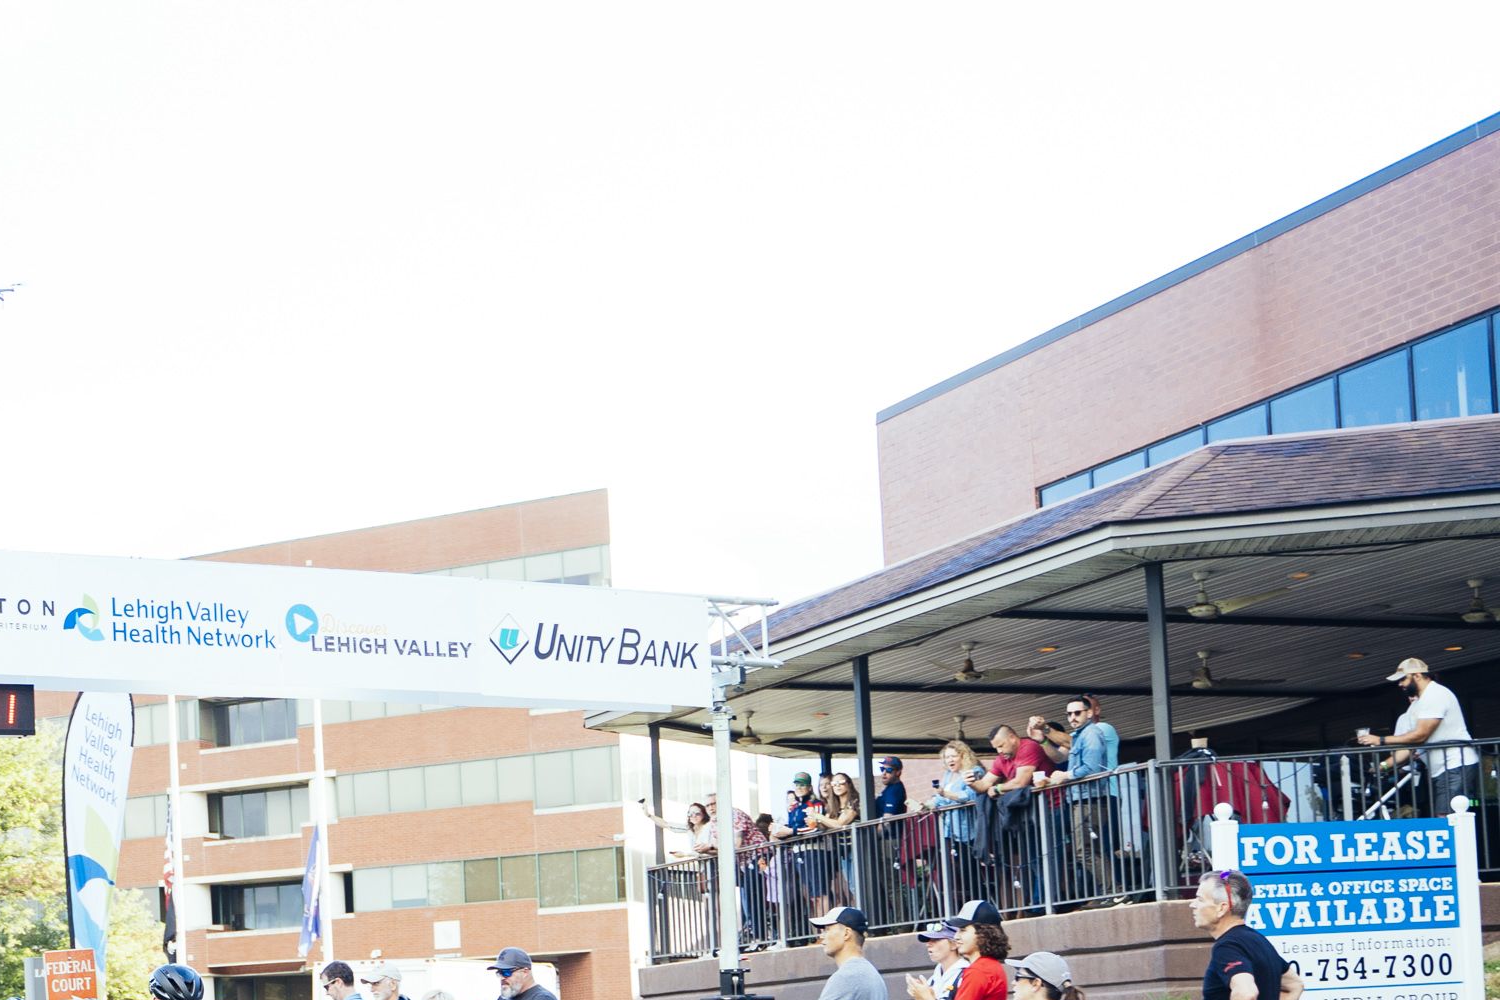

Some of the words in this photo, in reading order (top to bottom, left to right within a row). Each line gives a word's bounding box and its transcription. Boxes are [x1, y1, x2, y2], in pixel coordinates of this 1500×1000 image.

[112, 597, 182, 624] Lehigh
[186, 601, 249, 628] Valley
[112, 622, 181, 645] Health
[187, 626, 276, 649] Network
[311, 635, 388, 655] LEHIGH
[394, 638, 472, 659] VALLEY
[534, 623, 615, 664] UNITY
[617, 628, 699, 669] BANK
[85, 704, 123, 740] Lehigh
[84, 725, 117, 761] Valley
[79, 746, 116, 783] Health
[72, 764, 118, 808] Network
[1240, 834, 1322, 867] FOR
[1330, 829, 1450, 863] LEASE
[1252, 883, 1307, 899] ETAIL
[1310, 882, 1324, 896] &
[1328, 878, 1395, 895] OFFICE
[1398, 876, 1453, 893] SPACE
[1245, 895, 1455, 930] AVAILABLE
[1282, 939, 1344, 955] Leasing
[1350, 936, 1451, 951] Information:
[46, 960, 96, 976] FEDERAL
[51, 977, 91, 993] COURT
